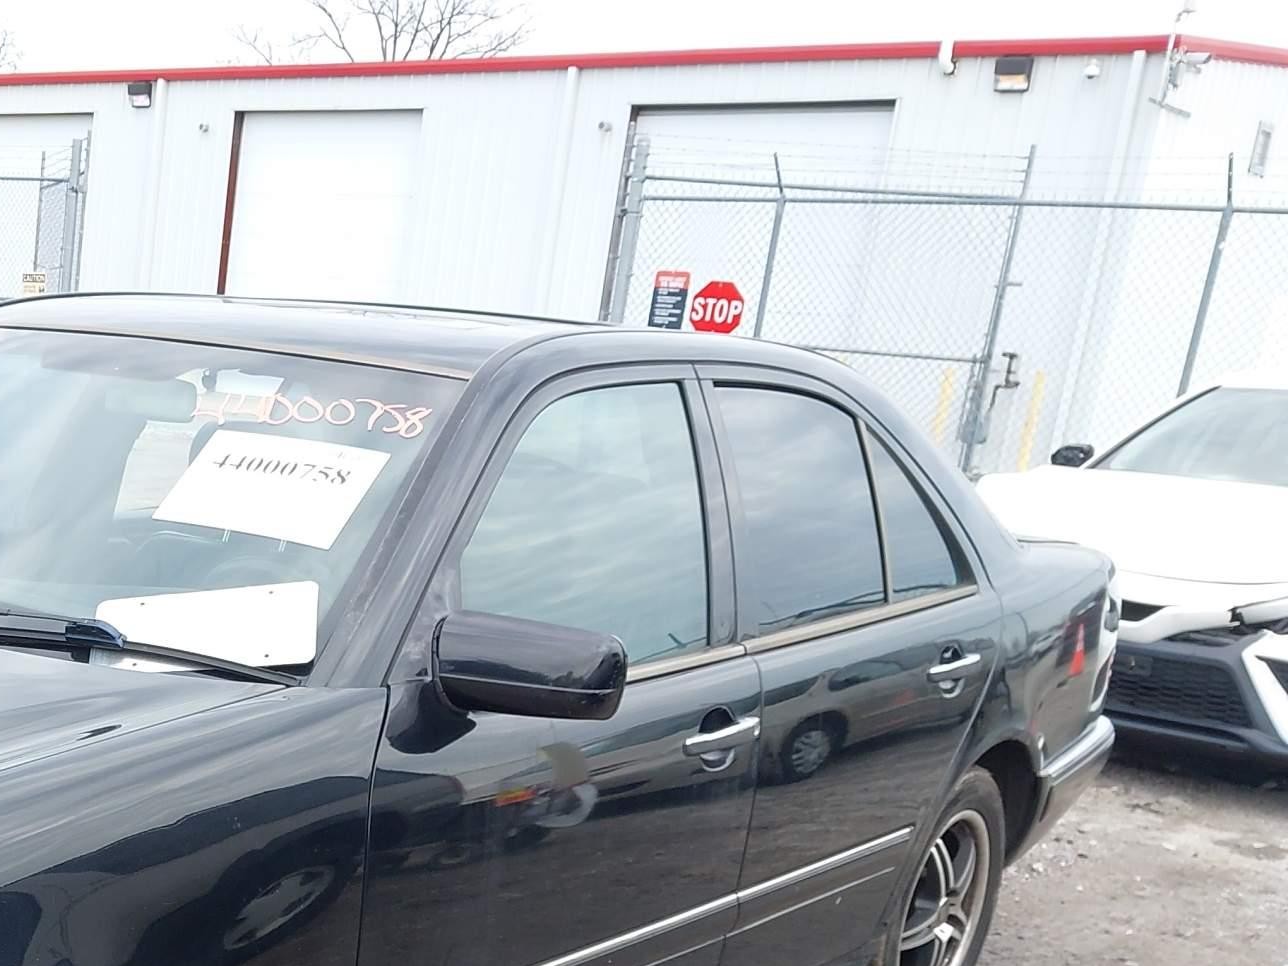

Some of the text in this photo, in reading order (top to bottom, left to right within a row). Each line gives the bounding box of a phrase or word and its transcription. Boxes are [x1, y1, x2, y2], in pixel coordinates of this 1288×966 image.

[691, 297, 743, 324] STOP
[191, 393, 432, 438] 44000758
[213, 453, 351, 485] 44000758
